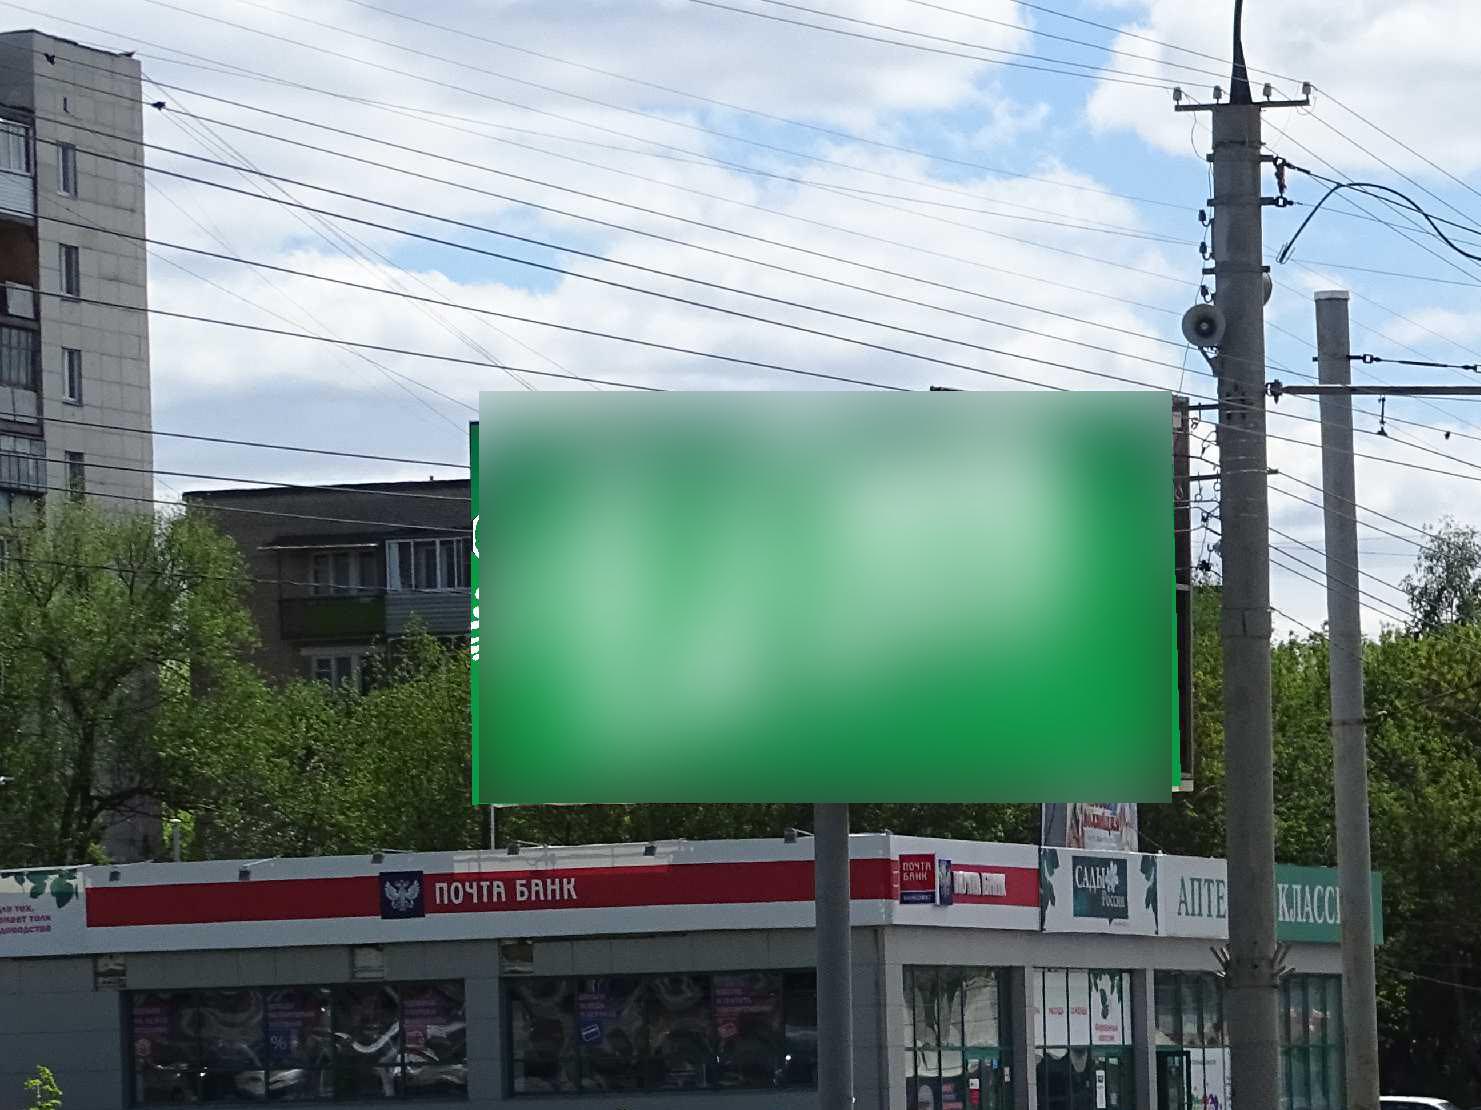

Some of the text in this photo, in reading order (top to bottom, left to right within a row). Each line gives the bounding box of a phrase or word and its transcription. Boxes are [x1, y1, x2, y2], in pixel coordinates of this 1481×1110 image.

[902, 861, 932, 871] ПОЧТА
[903, 871, 928, 881] БАНК
[434, 878, 577, 905] ПОЧТА БАНК
[1178, 875, 1227, 919] АПТЕ
